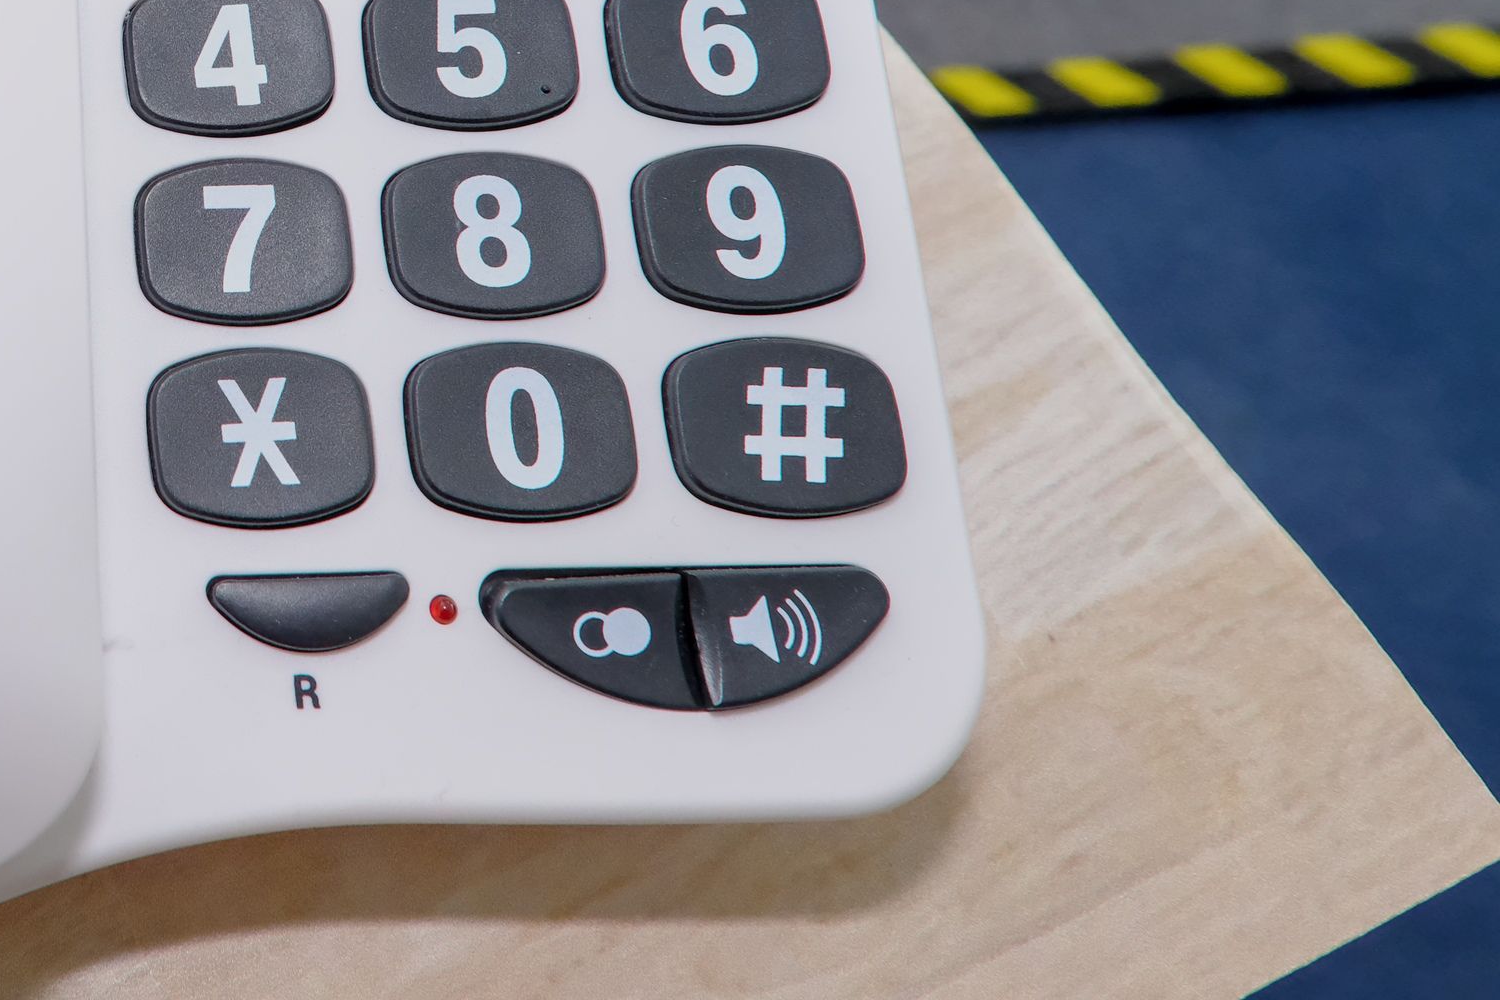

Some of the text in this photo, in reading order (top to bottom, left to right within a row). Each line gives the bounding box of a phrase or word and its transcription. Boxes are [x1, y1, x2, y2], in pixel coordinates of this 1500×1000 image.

[193, 3, 268, 106] 4
[202, 184, 277, 293] 7
[453, 174, 532, 288] 8
[705, 164, 786, 280] 9
[485, 366, 565, 490] 0
[293, 673, 321, 710] R
